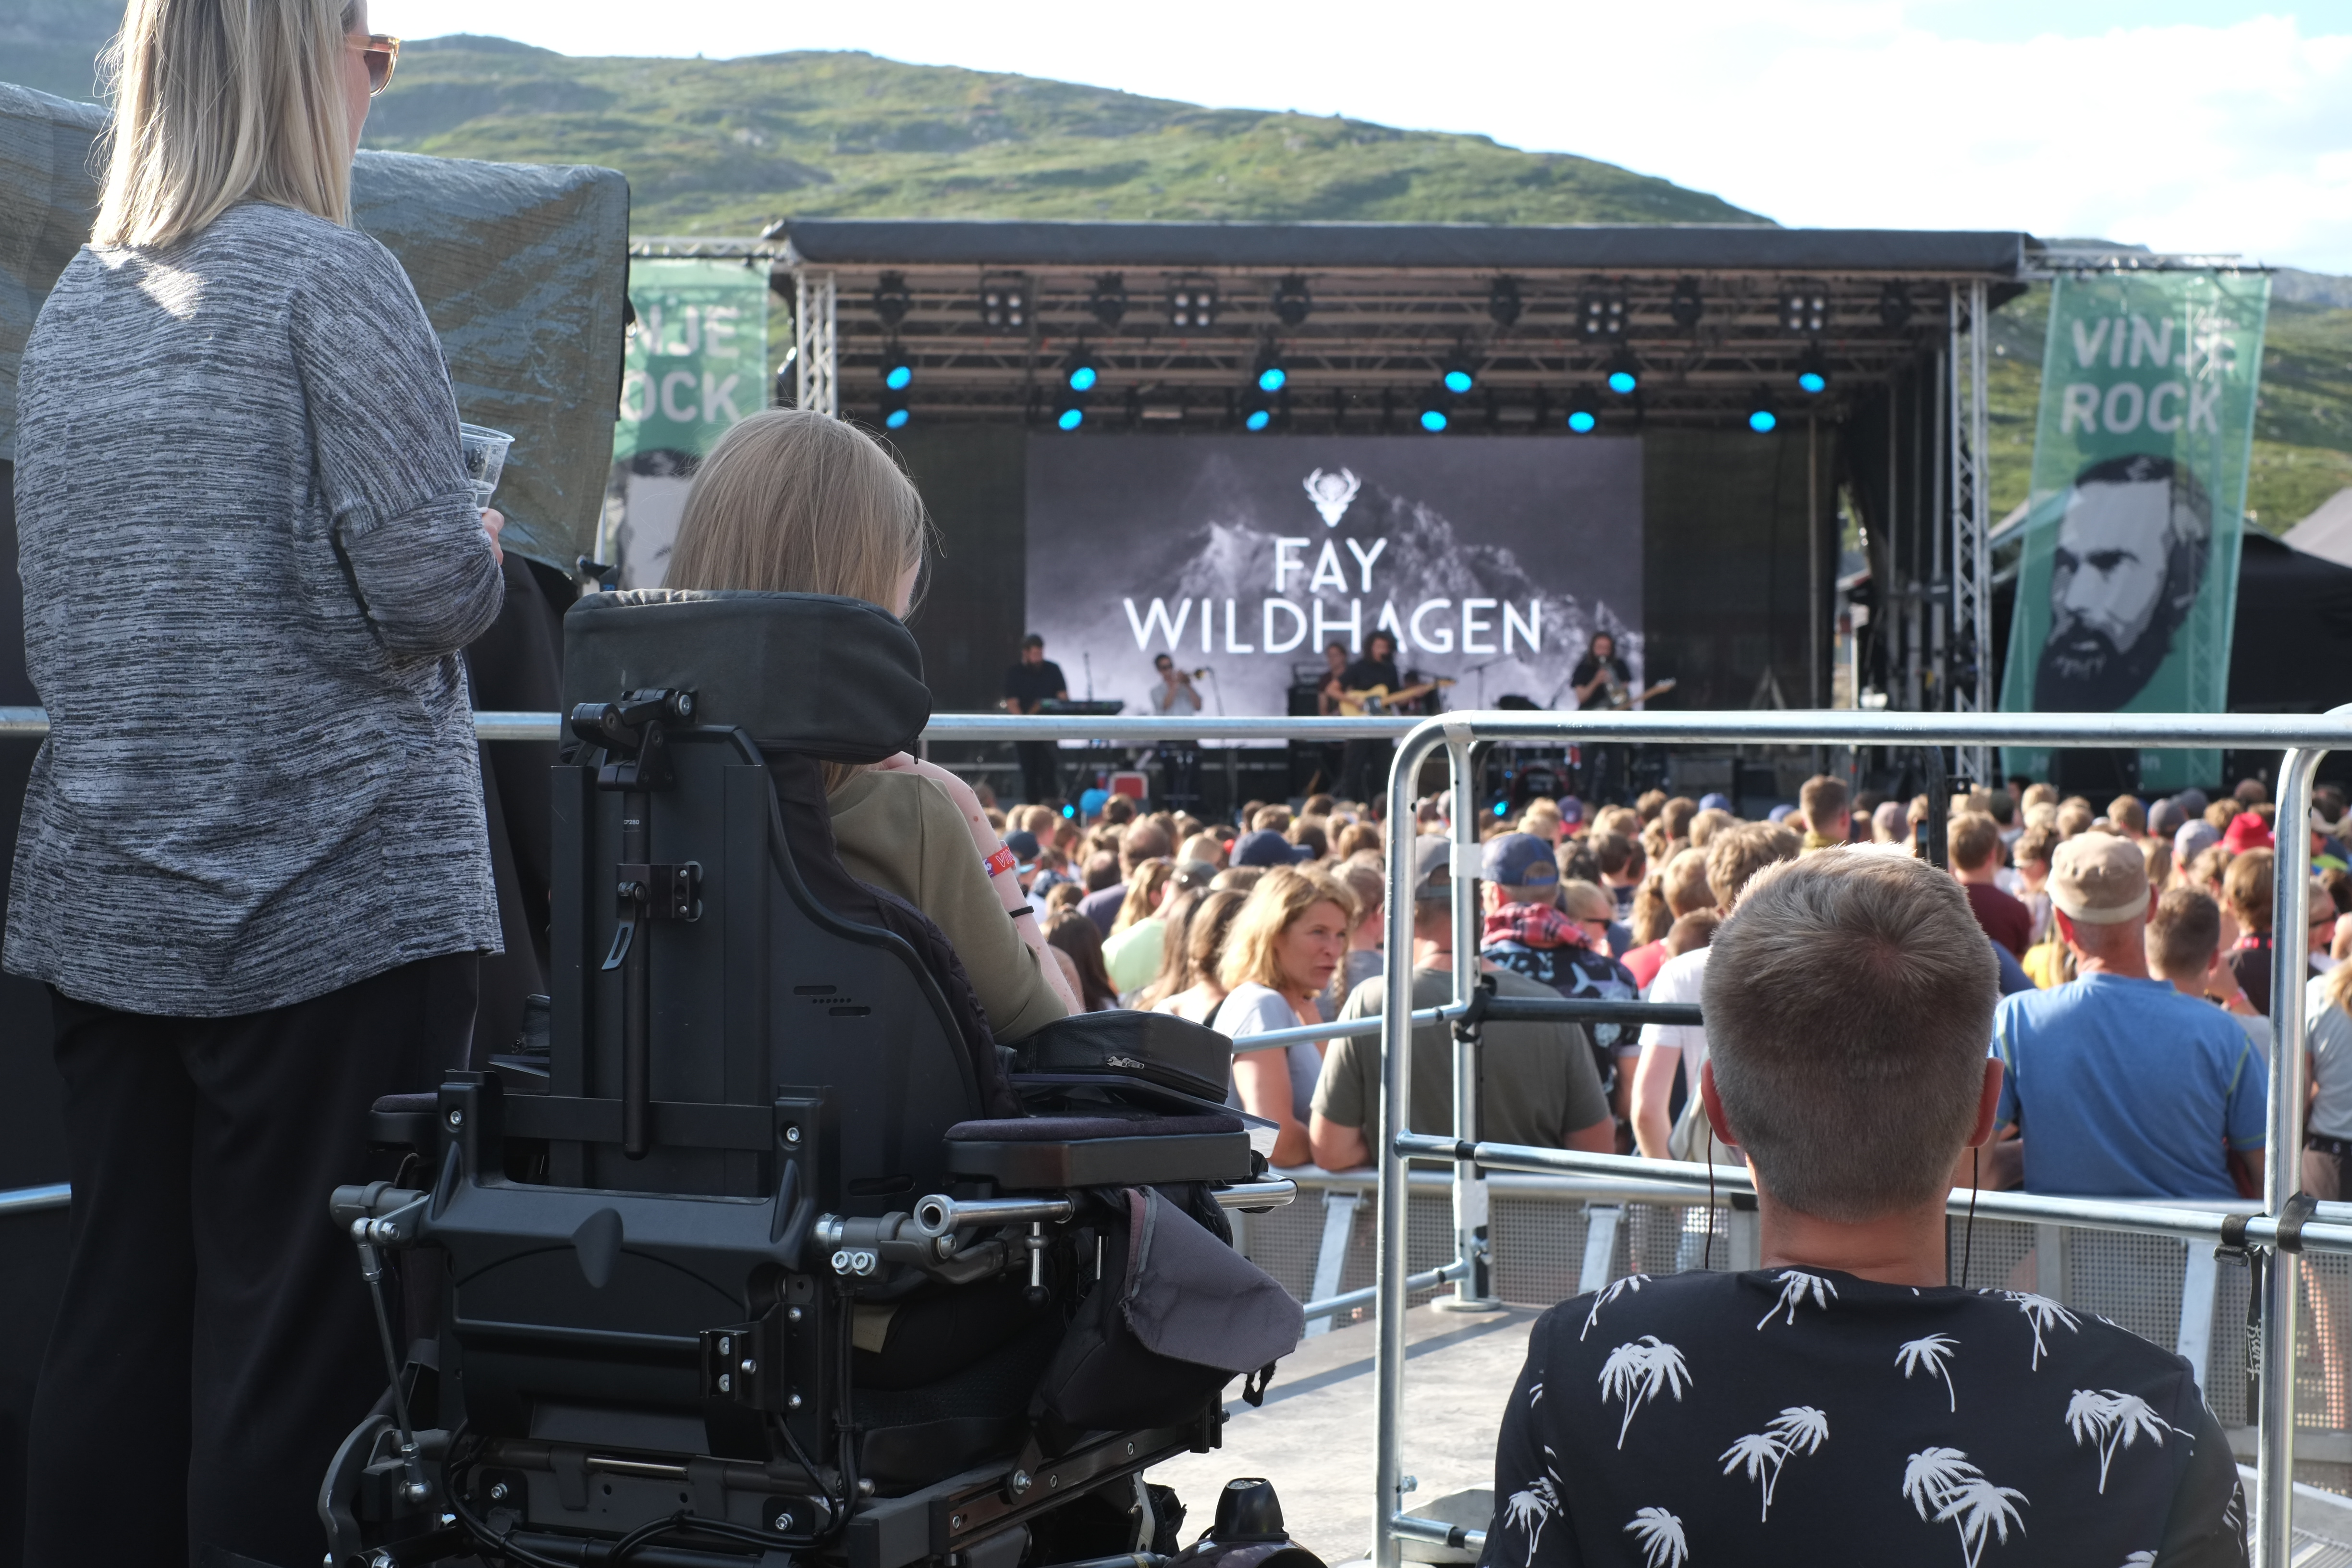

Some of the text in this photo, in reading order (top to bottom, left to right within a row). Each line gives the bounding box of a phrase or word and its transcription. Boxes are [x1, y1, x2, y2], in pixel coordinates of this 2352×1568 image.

[626, 305, 741, 357] NJE
[621, 370, 743, 423] OCK
[2061, 382, 2219, 433] ROCK
[1275, 538, 1388, 593] FAY
[1123, 598, 1541, 654] WILDHAGEN
[996, 849, 1014, 868] VIN
